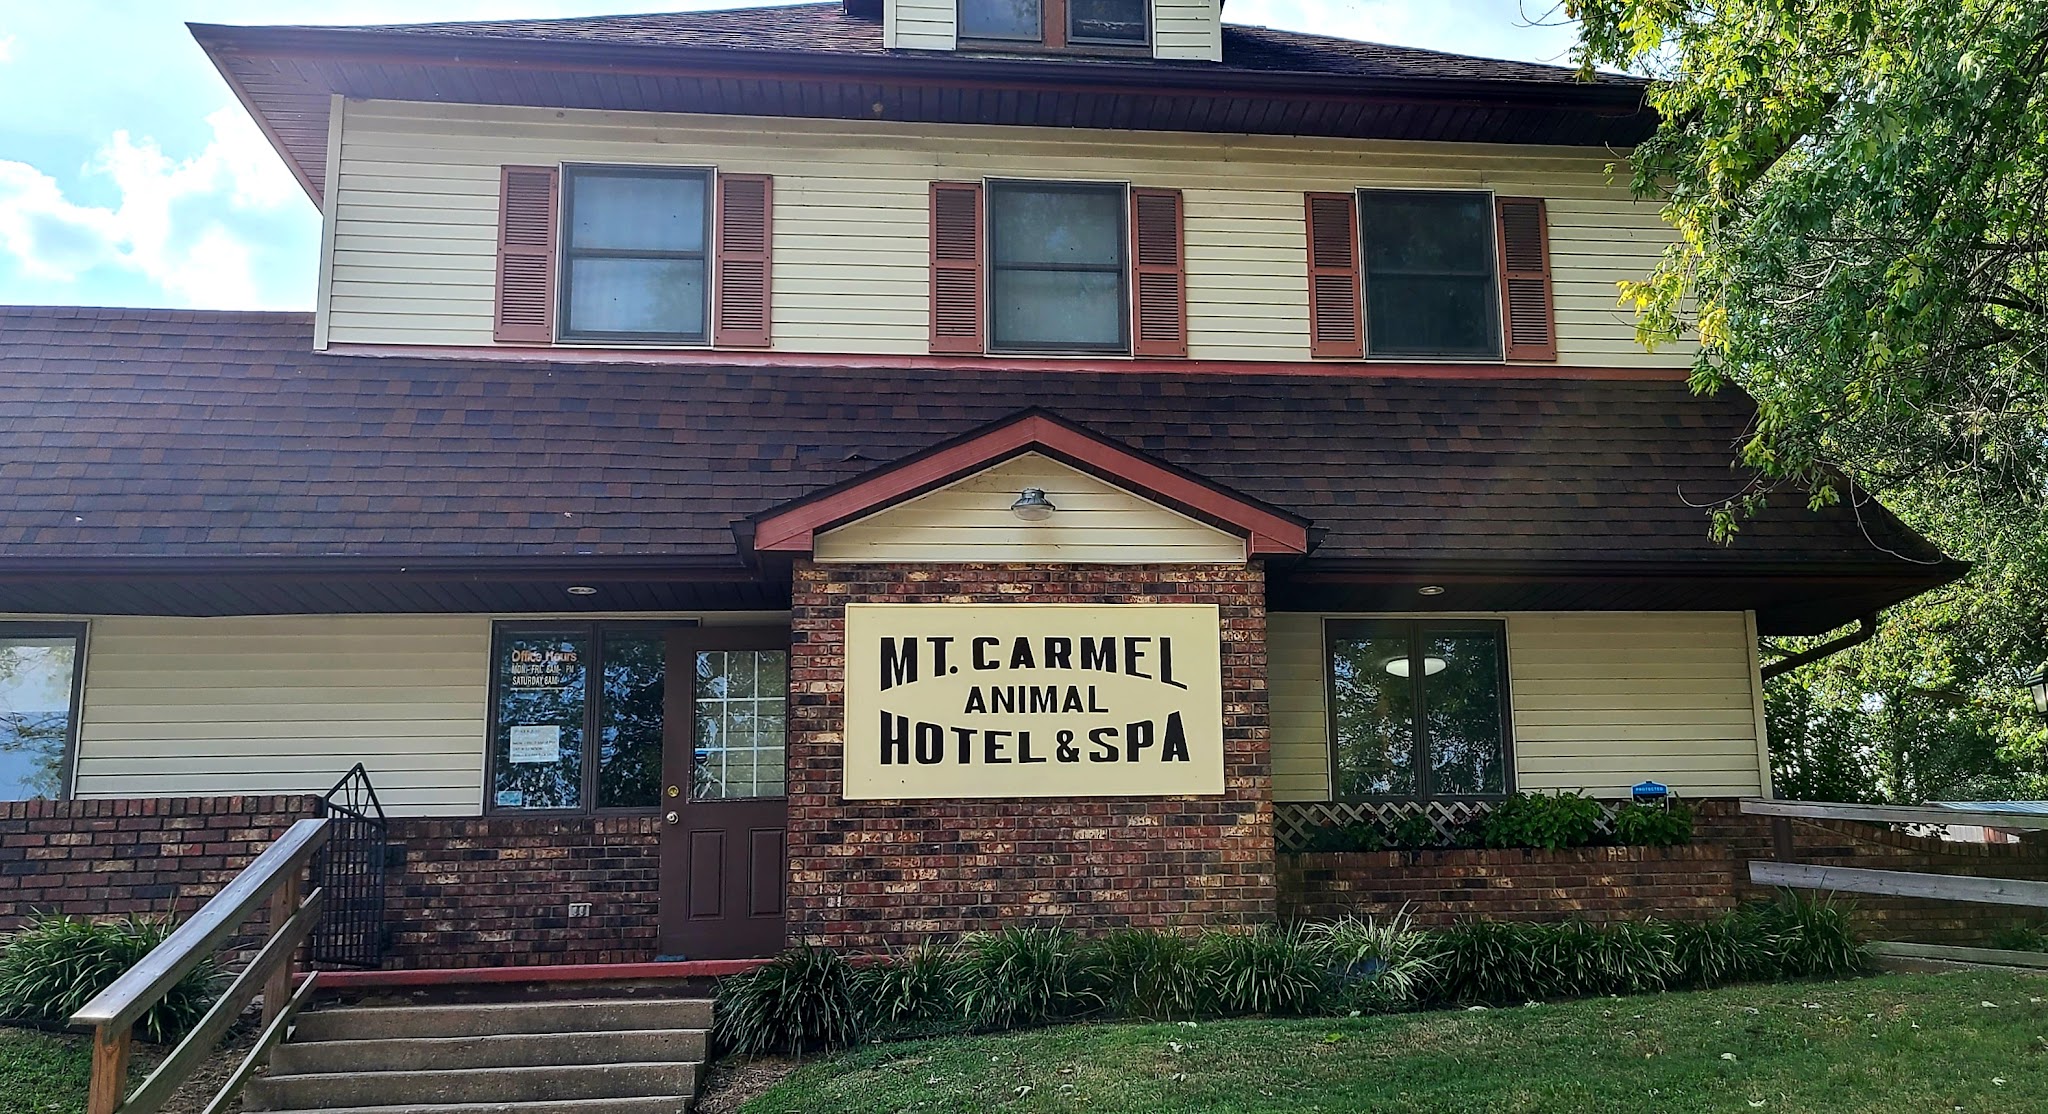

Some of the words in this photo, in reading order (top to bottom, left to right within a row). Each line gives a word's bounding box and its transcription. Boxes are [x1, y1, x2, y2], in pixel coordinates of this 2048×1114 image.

[511, 650, 542, 662] Office
[545, 650, 577, 662] Hours
[880, 637, 958, 691] MT.
[972, 637, 1188, 690] CARMEL
[512, 675, 544, 686] SATURDAY
[964, 685, 1109, 713] ANIMAL
[880, 710, 1047, 765] HOTEL
[1056, 729, 1080, 763] &
[1088, 711, 1191, 763] SPA
